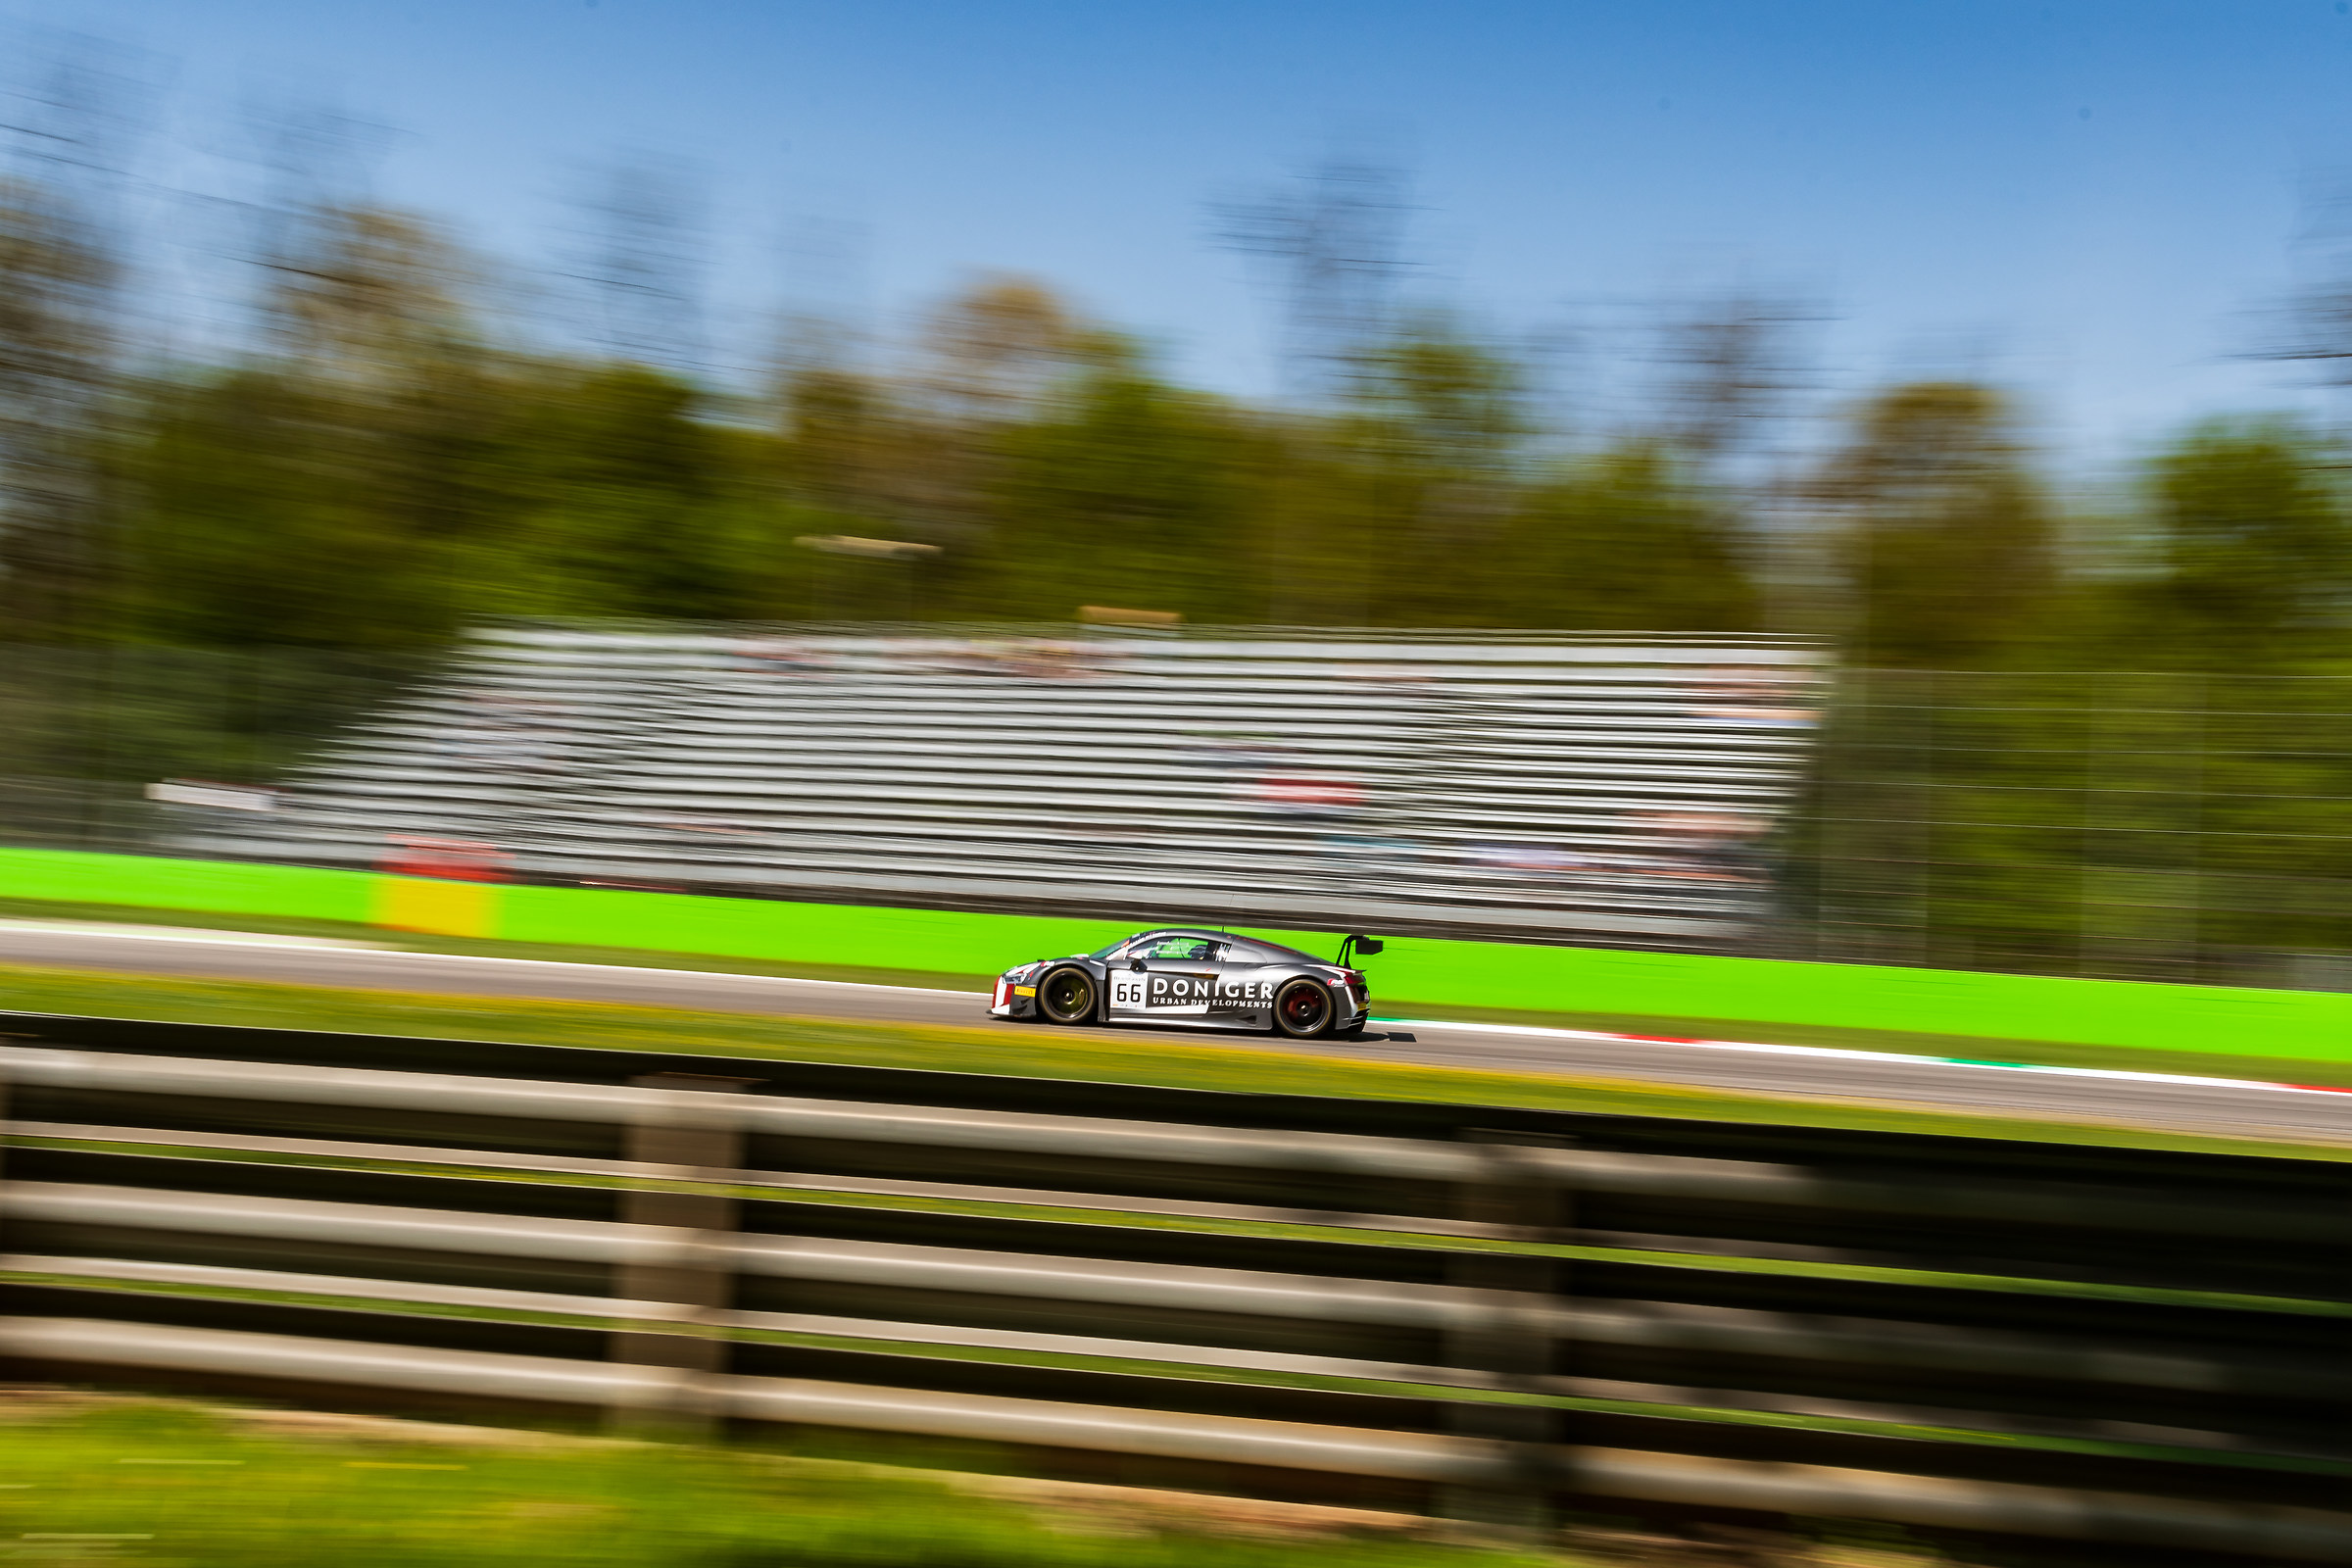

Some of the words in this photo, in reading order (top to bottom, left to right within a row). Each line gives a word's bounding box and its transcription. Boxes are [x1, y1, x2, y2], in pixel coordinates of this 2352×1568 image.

[1117, 983, 1141, 1003] 66
[1153, 978, 1273, 999] DONIGER
[1191, 999, 1273, 1009] DEVELOPMENTS
